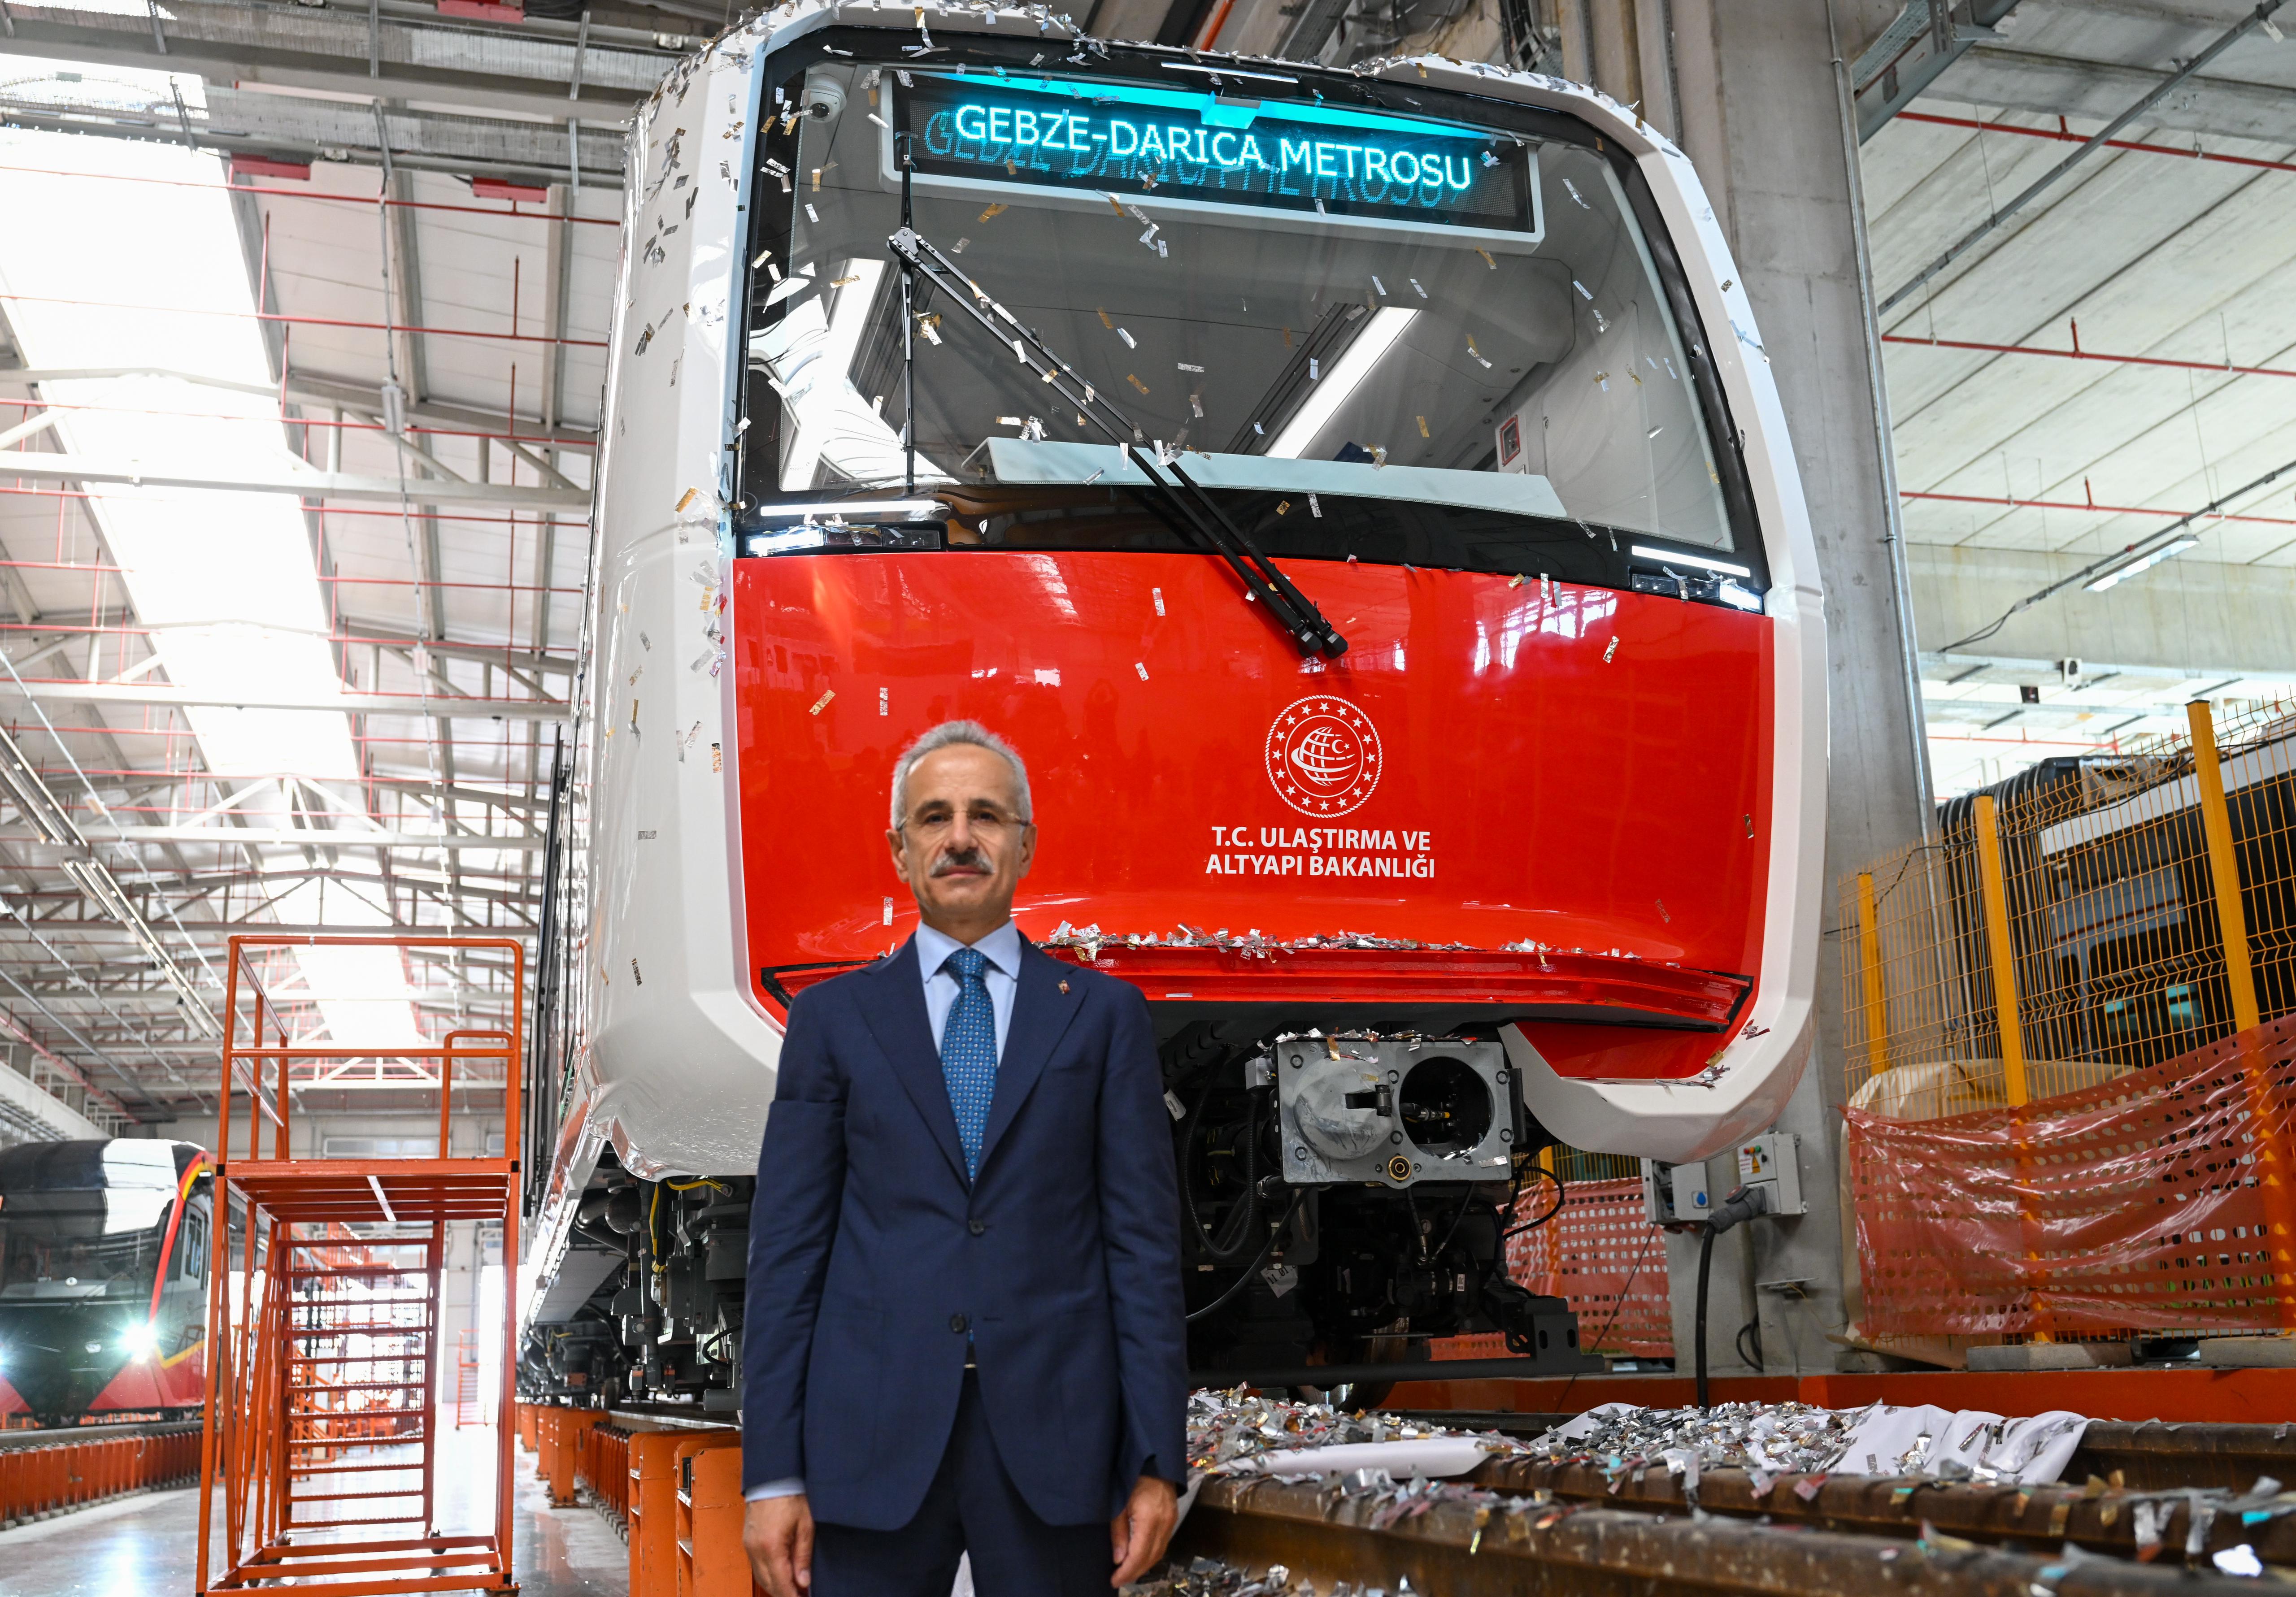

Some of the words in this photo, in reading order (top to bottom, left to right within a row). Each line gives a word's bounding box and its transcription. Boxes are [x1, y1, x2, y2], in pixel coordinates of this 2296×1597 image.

[955, 104, 1263, 168] GEBZE-DARICA
[1279, 138, 1471, 190] METROSU
[1212, 826, 1254, 847] T.C.
[1261, 827, 1397, 854] ULAŞTIRMA
[1402, 831, 1430, 851] VE
[1205, 855, 1302, 875] ALTYAPI
[1310, 854, 1435, 878] BAKANLIĞI
